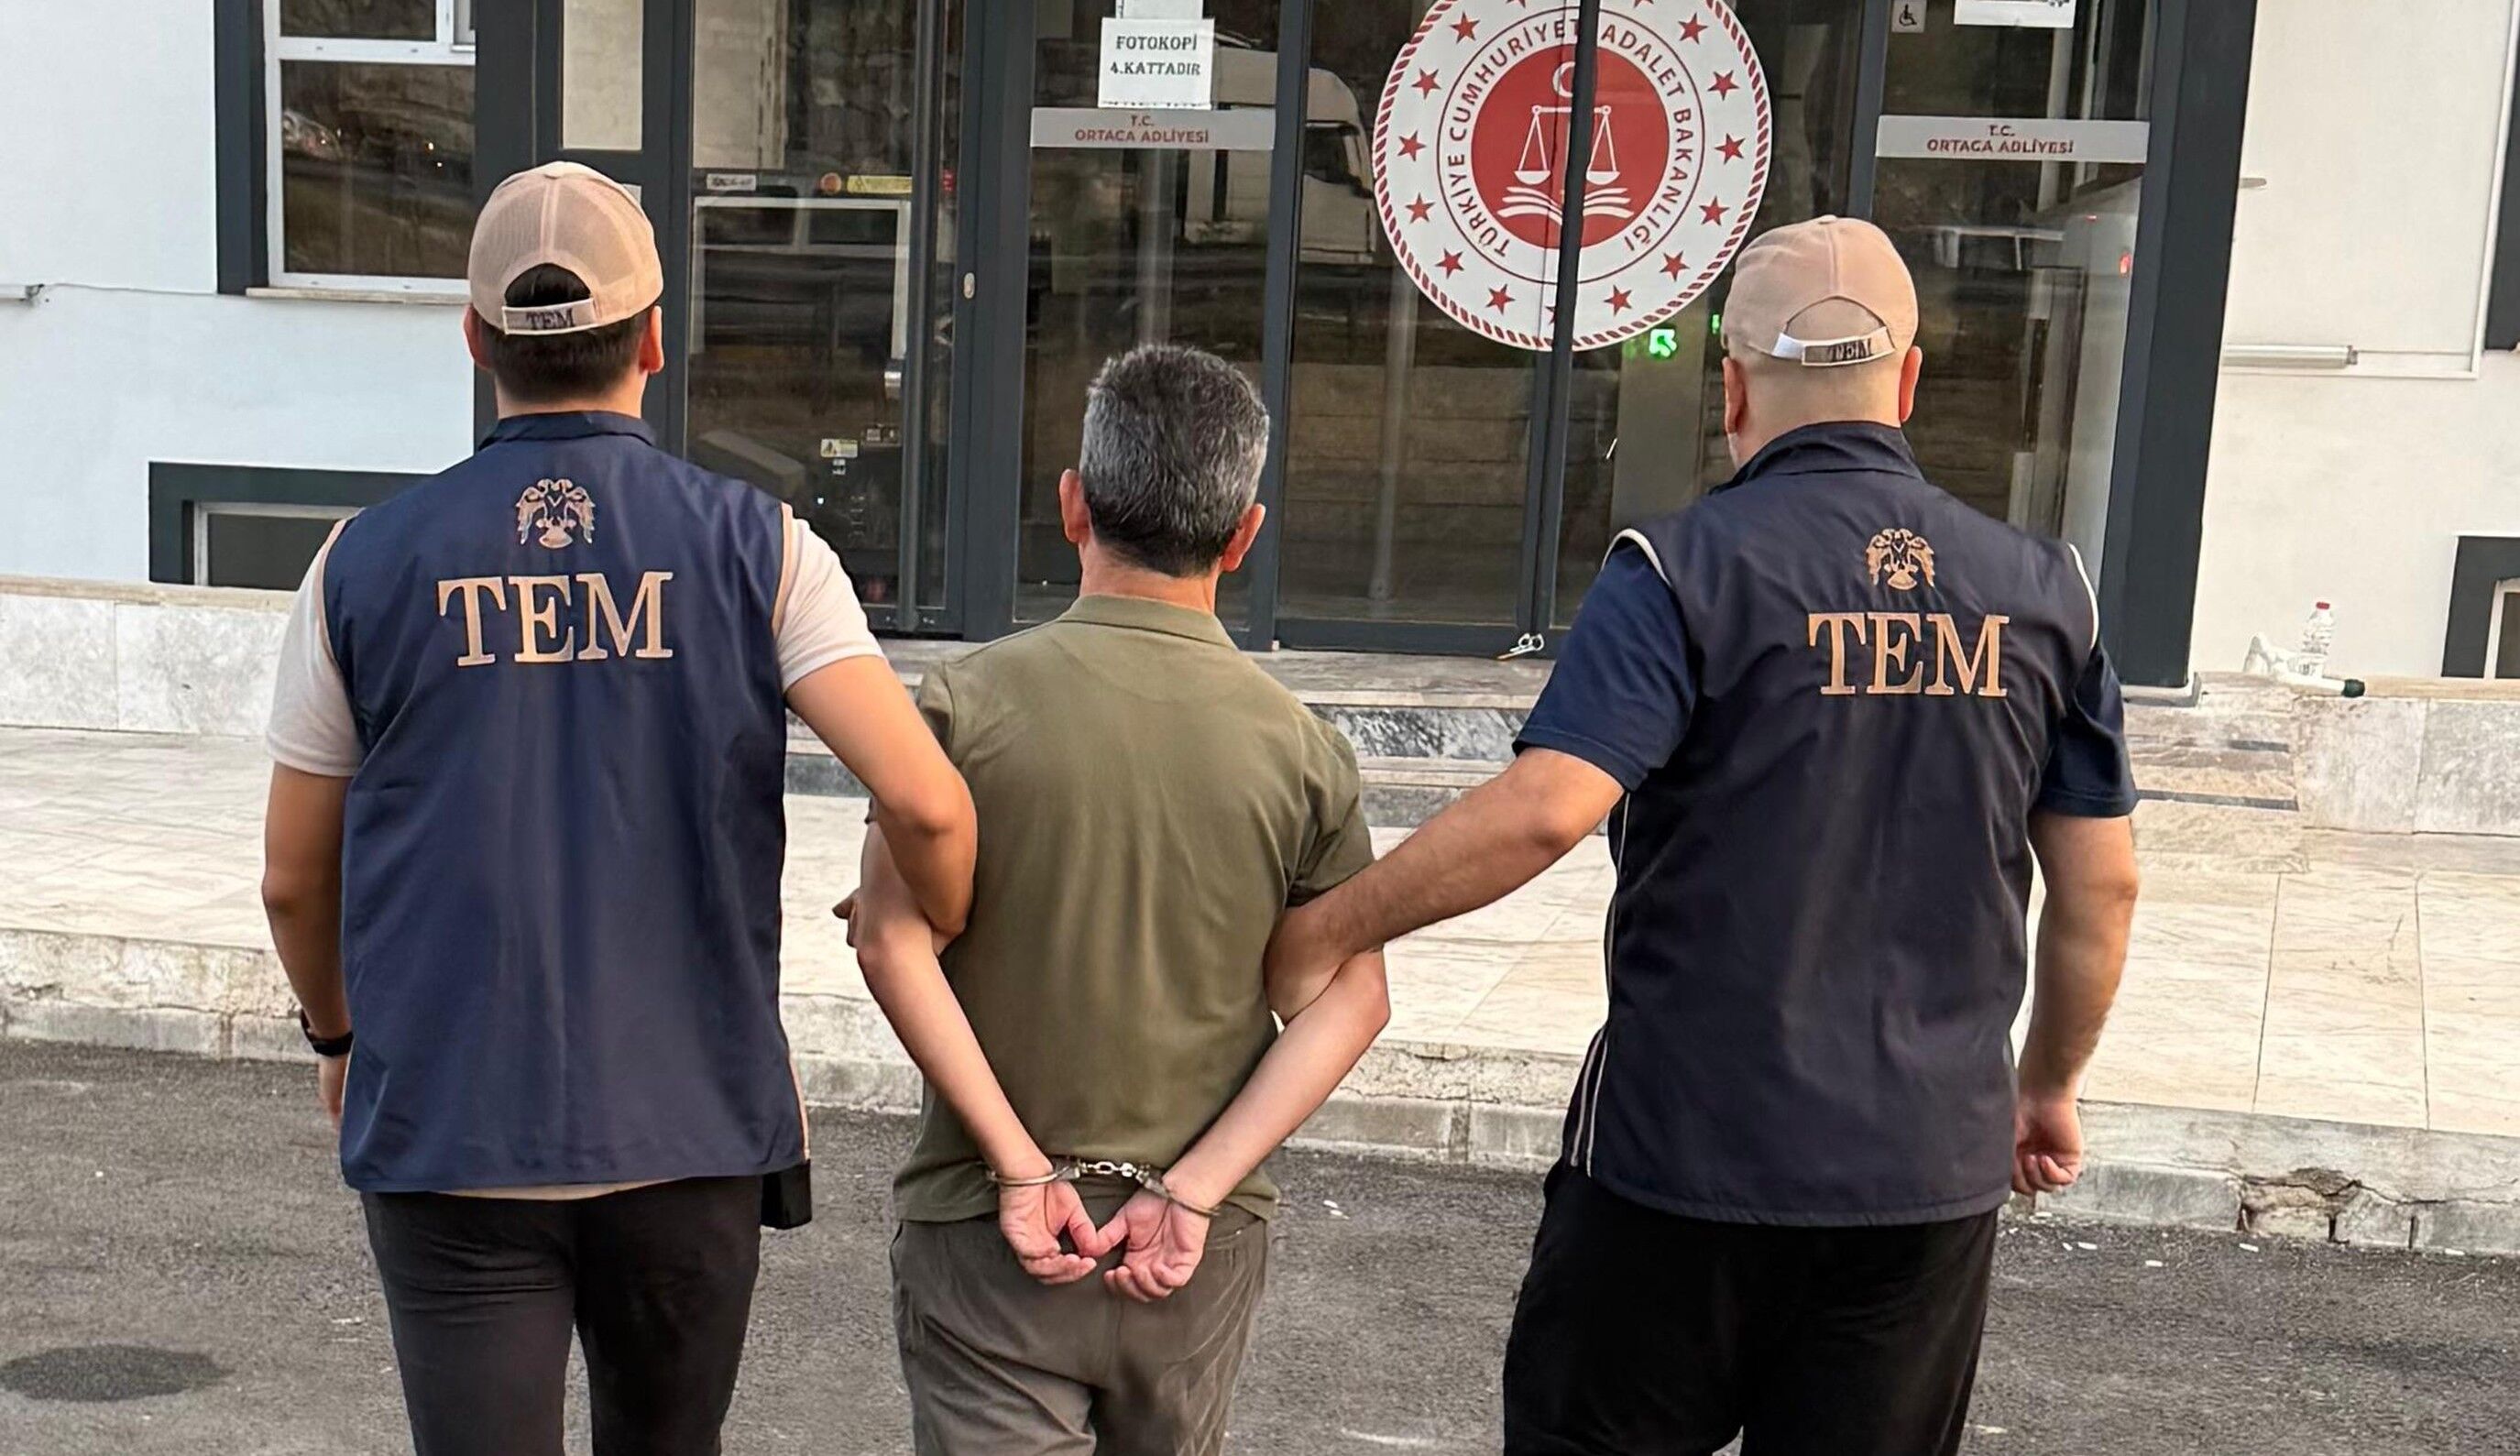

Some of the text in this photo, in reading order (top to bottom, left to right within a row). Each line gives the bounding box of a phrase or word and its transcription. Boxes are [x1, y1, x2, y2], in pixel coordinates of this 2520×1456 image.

[1116, 33, 1197, 50] FOTOKOPİ
[1110, 60, 1200, 75] 4.KATTADIR
[1601, 24, 1685, 97] ADALET
[1131, 115, 1155, 126] T.C.
[1075, 127, 1209, 143] ORTACA ADLİYESİ
[1989, 125, 2015, 137] T.C.
[1927, 137, 2074, 154] ORTACA ADLİYESİ
[1624, 107, 1694, 252] BAKANLIĞI
[1447, 154, 1510, 257] TÜRKİYE
[526, 307, 575, 330] TEM
[438, 571, 674, 667] TEM
[1808, 612, 2011, 697] TEM
